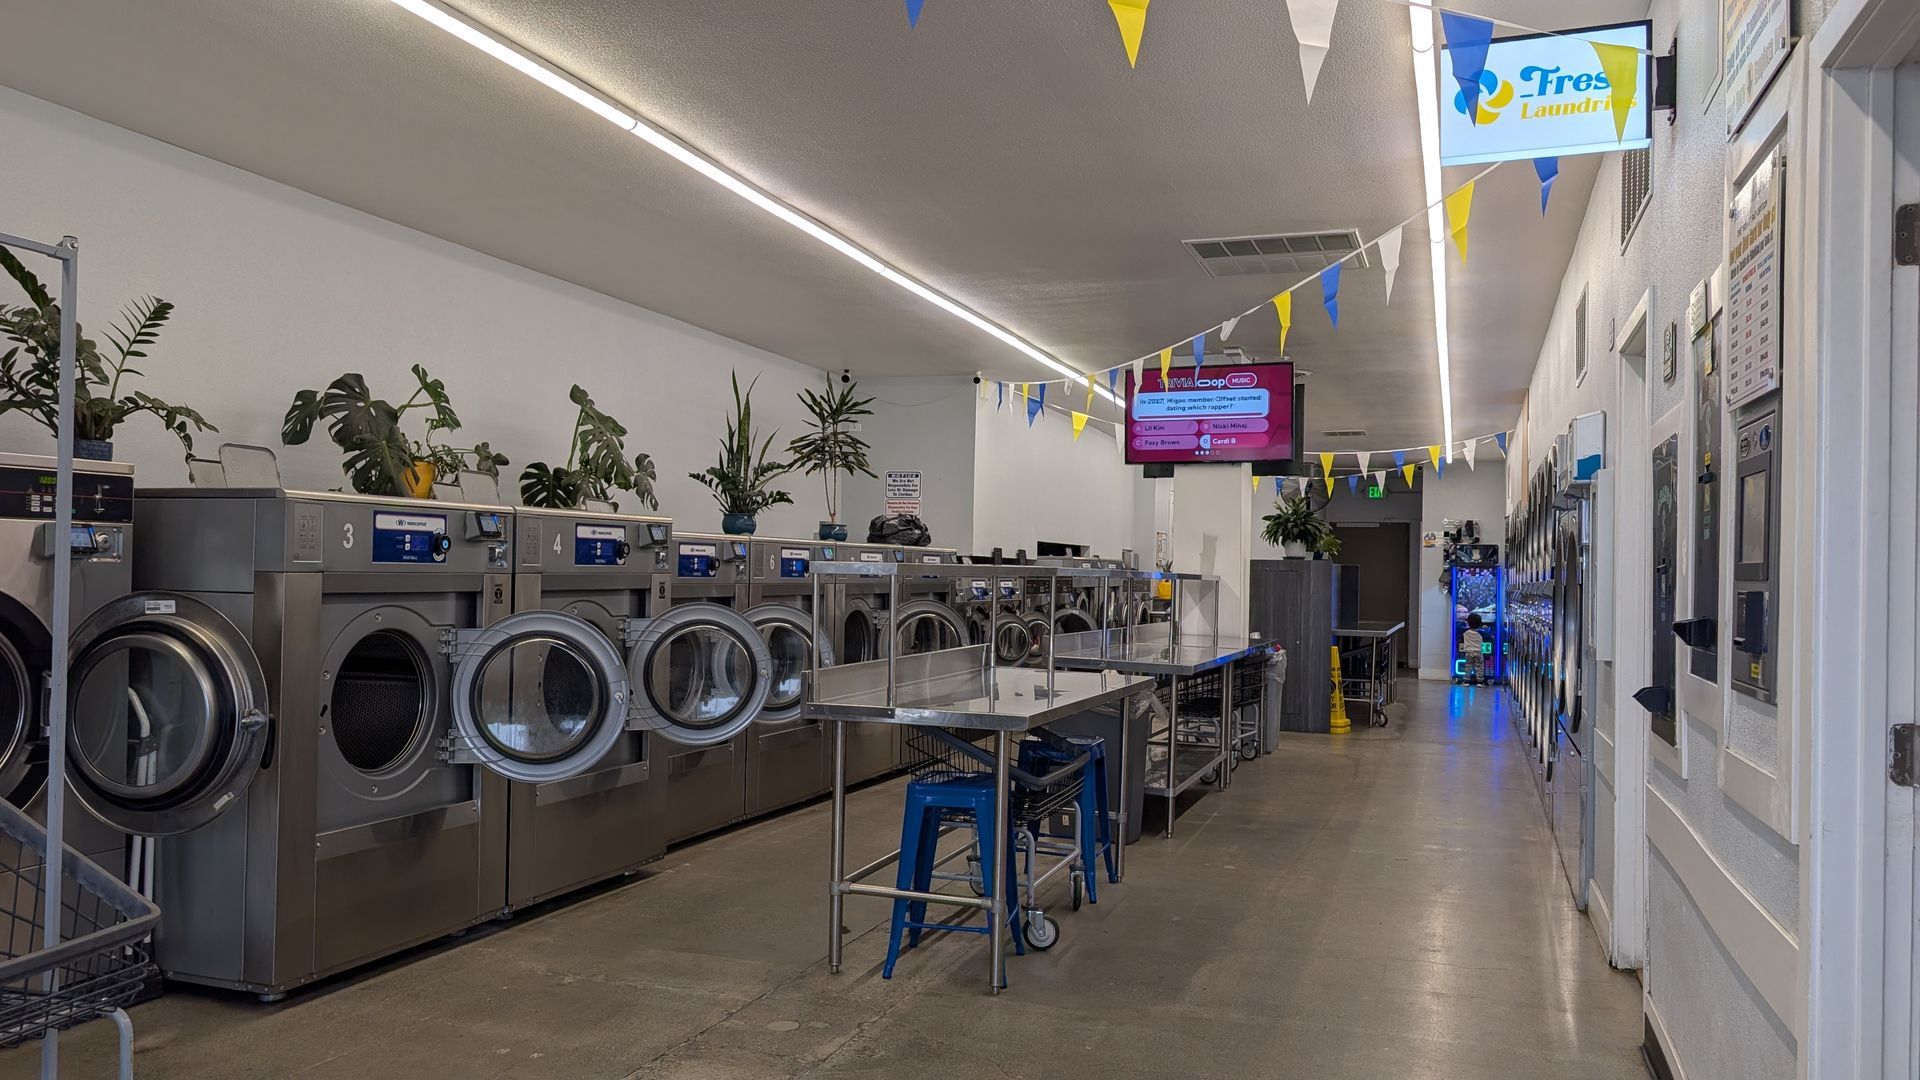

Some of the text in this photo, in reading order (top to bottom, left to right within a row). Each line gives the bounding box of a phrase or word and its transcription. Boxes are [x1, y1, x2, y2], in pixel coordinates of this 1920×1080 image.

[1520, 62, 1632, 98] Fres
[1520, 95, 1637, 120] Laundris
[1157, 377, 1195, 388] TRIVIA
[1166, 397, 1186, 405] Migos
[1212, 437, 1229, 445] Cardi
[342, 523, 354, 549] 3
[553, 533, 562, 555] 4
[769, 555, 775, 570] 6
